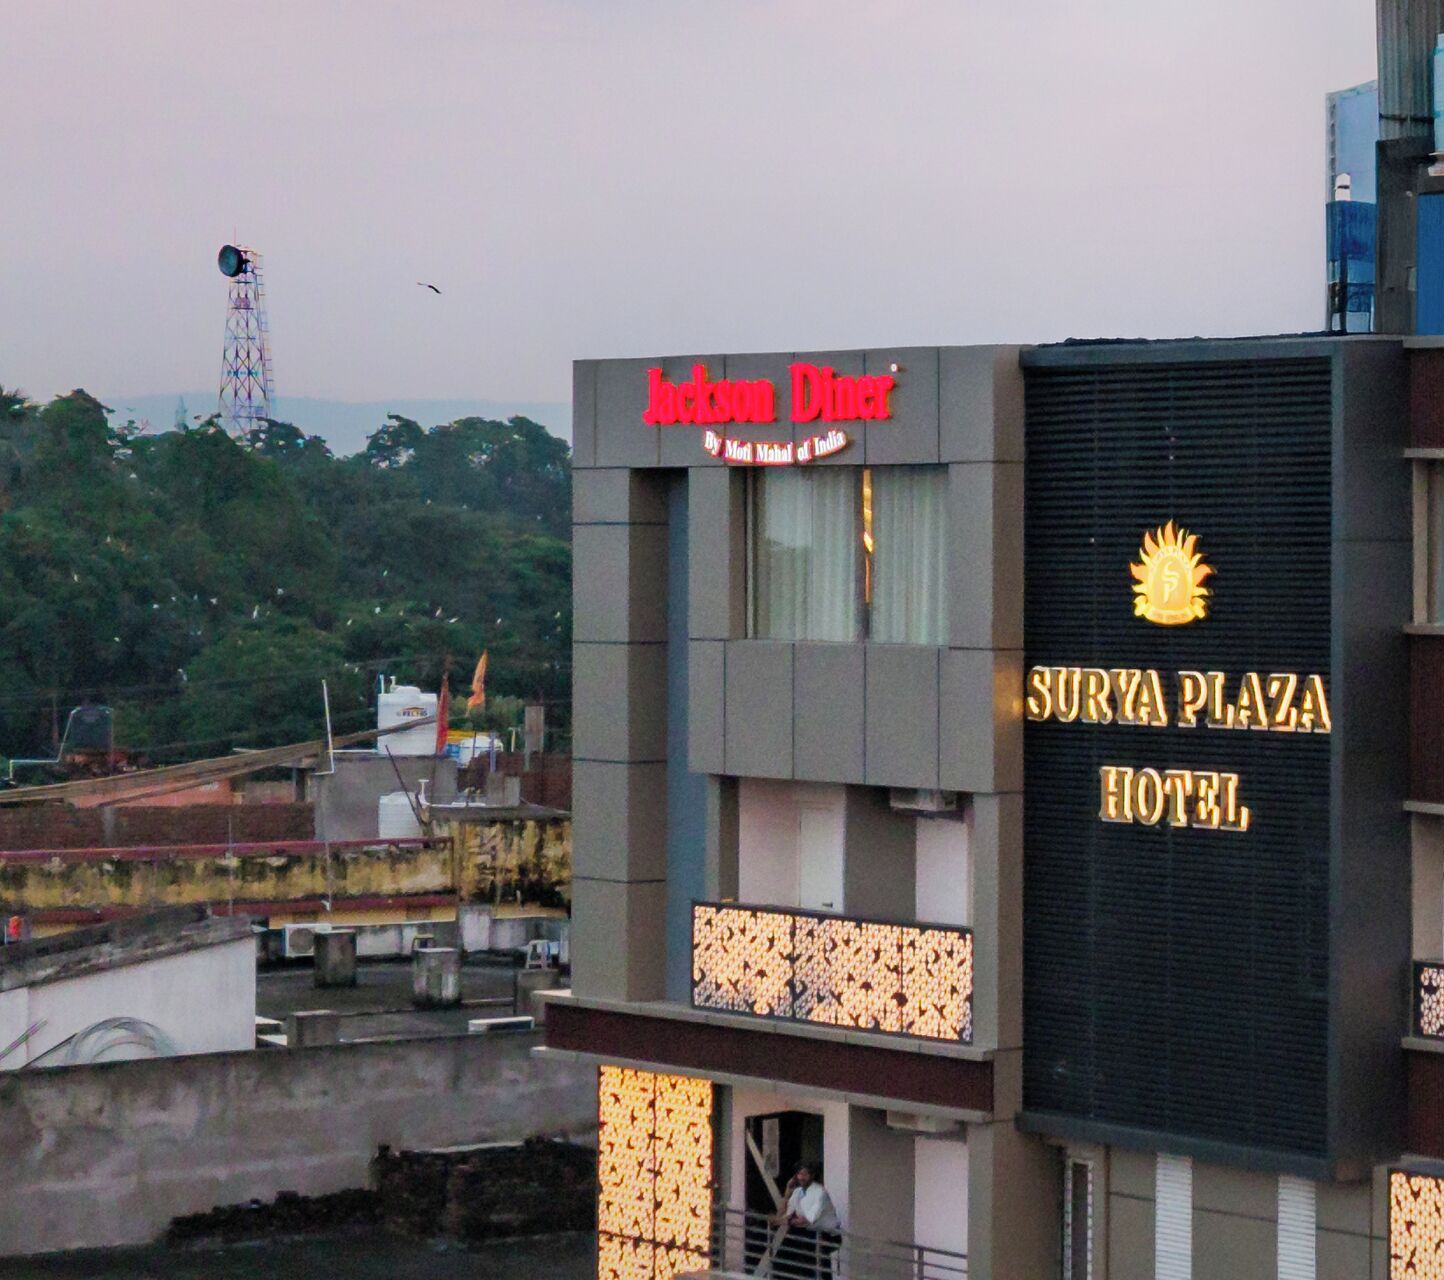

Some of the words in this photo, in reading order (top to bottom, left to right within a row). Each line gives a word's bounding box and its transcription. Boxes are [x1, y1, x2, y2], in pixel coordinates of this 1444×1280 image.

[643, 363, 777, 425] Jackson
[789, 362, 895, 423] Diner
[704, 428, 722, 457] By
[724, 439, 752, 463] Moti
[755, 441, 793, 464] Mahal
[797, 439, 811, 463] of
[813, 429, 847, 457] India
[1026, 665, 1168, 726] SURYA
[1177, 671, 1332, 734] PLAZA
[1099, 766, 1252, 832] HOTEL
